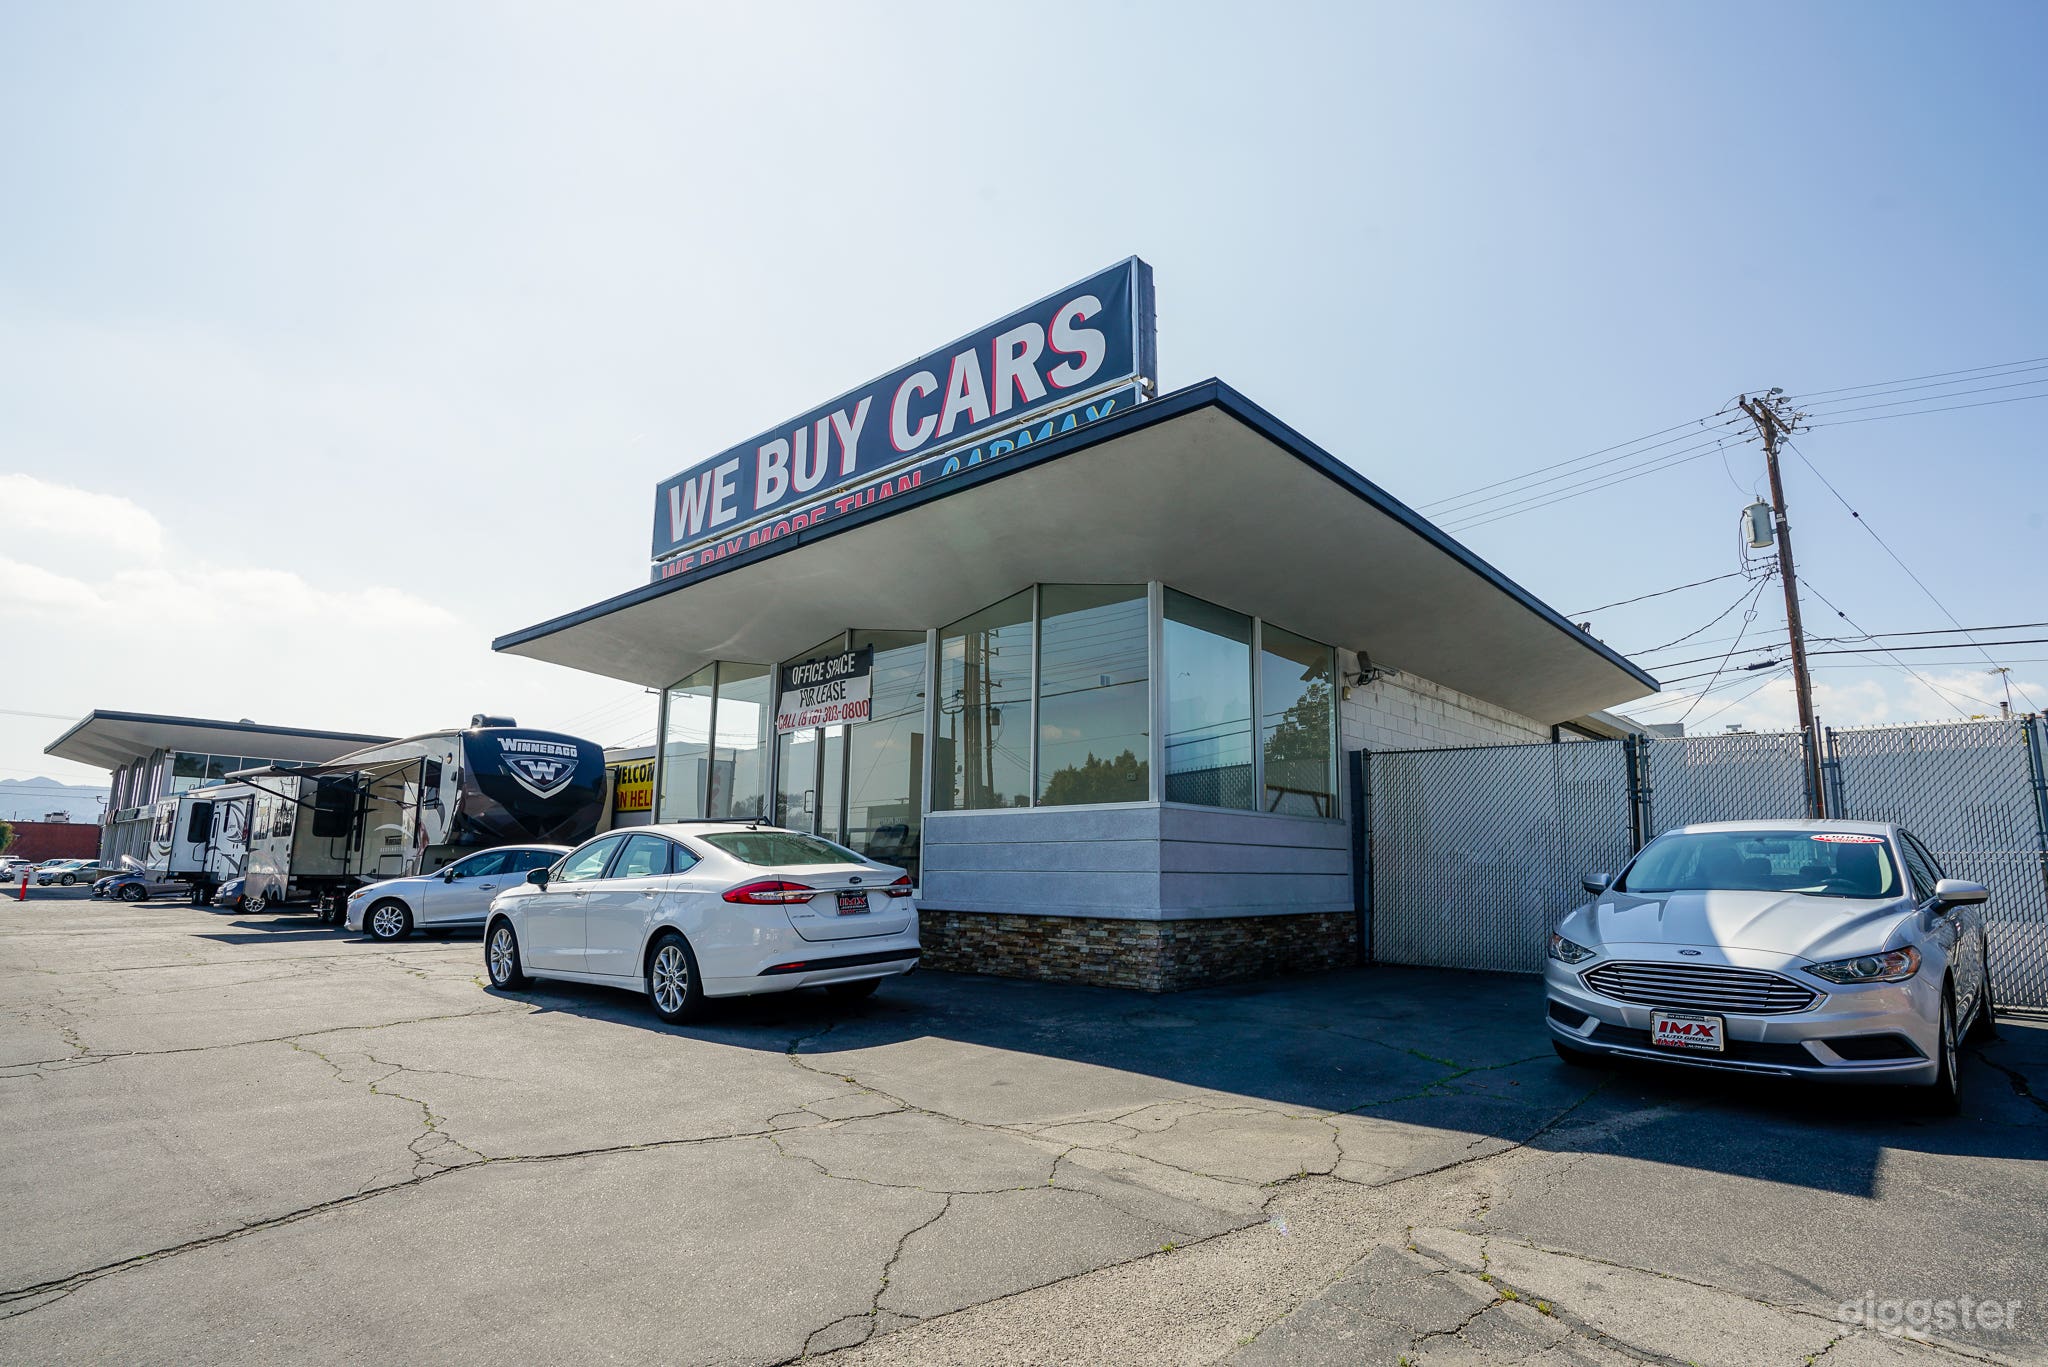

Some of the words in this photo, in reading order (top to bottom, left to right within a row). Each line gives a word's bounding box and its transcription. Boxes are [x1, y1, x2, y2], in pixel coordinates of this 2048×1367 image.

[668, 456, 740, 543] WE
[753, 395, 873, 511] BUY
[889, 294, 1107, 452] CARS
[792, 662, 825, 685] OFFICE
[825, 653, 856, 679] SPACE
[800, 688, 816, 708] FOR
[816, 680, 847, 704] LEASE
[778, 712, 797, 730] CALL
[822, 700, 869, 723] 303-0800
[497, 737, 578, 758] WINNEBAGO
[1658, 1020, 1717, 1038] IMX
